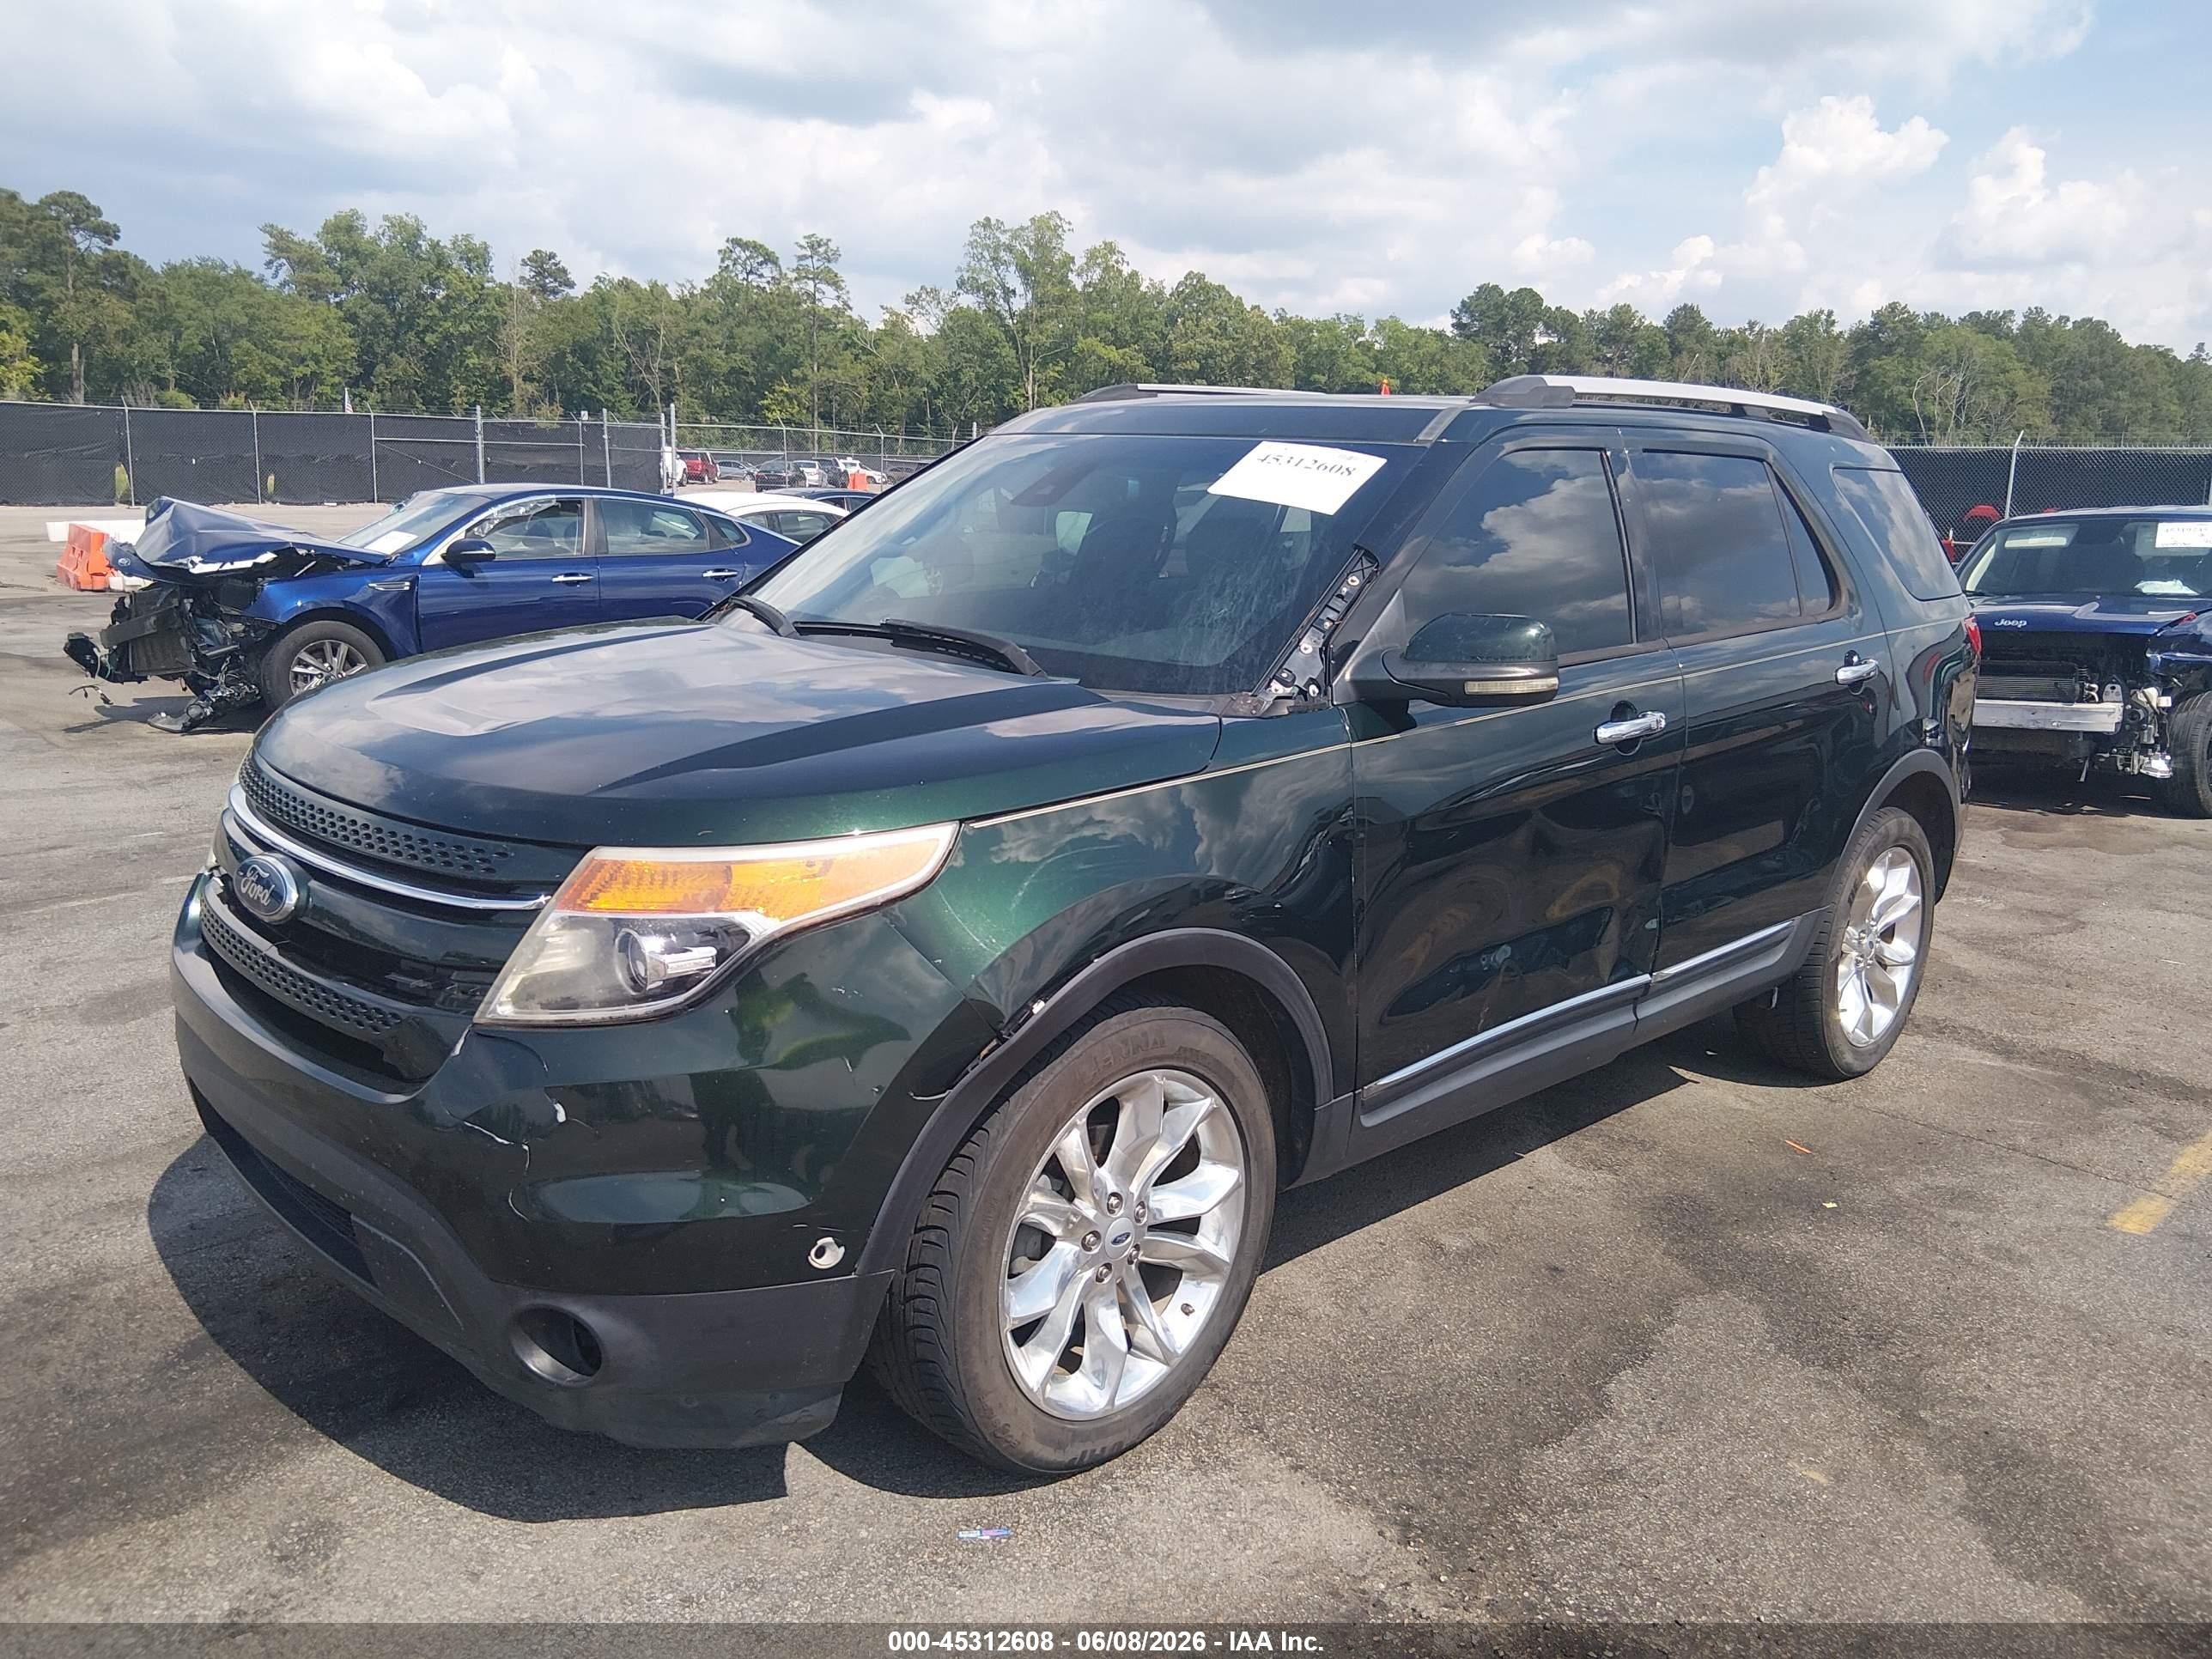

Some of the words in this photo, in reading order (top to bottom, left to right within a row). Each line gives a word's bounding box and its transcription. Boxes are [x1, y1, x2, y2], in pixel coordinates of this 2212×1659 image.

[1257, 453, 1357, 477] 45312608
[1994, 618, 2027, 628] Jeep
[238, 864, 276, 907] Ford
